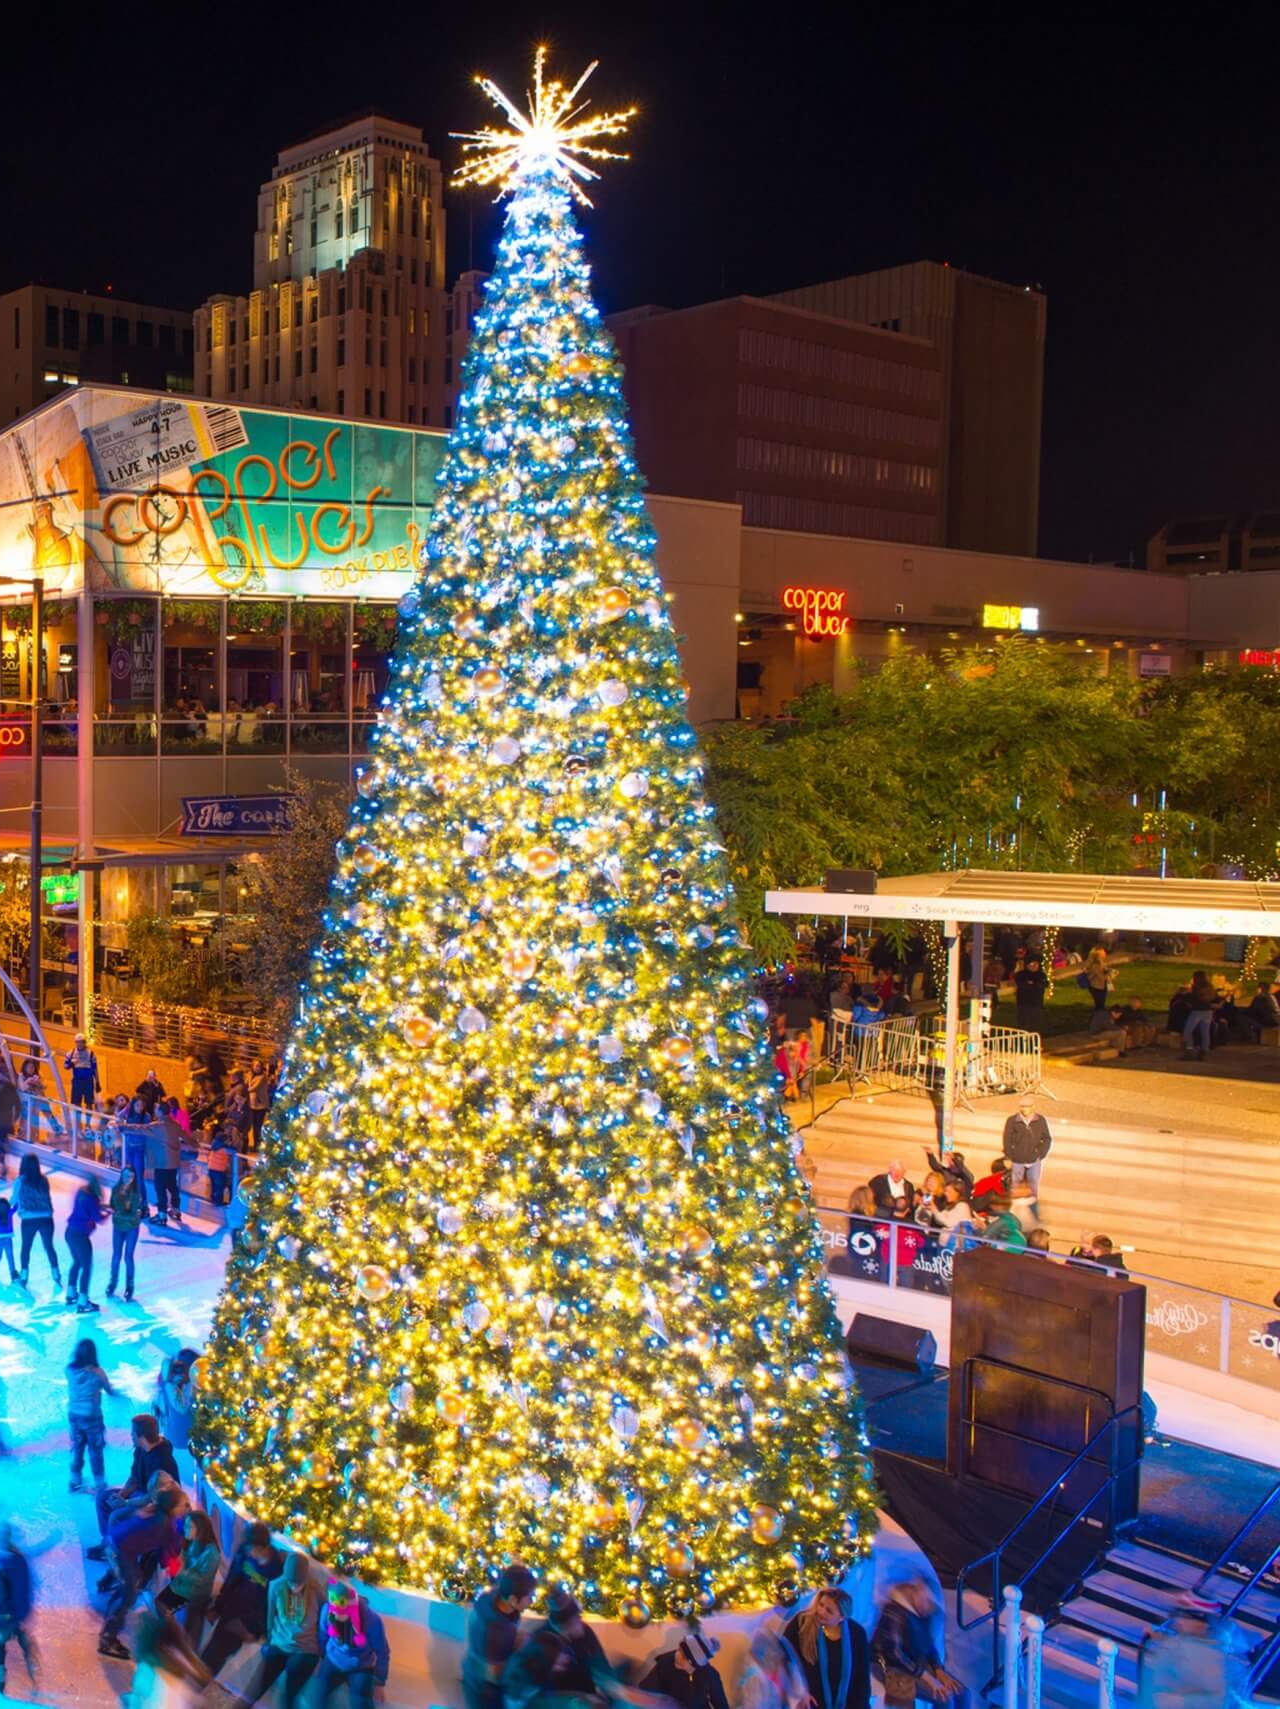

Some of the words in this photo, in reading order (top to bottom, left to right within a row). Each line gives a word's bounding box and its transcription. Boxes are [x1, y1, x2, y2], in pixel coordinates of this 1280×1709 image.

[151, 418, 170, 434] 4-7
[108, 460, 143, 483] LIVE
[147, 440, 197, 469] MUSIC
[103, 428, 341, 546] copper
[205, 486, 388, 590] blues
[320, 557, 372, 592] ROCK
[372, 544, 410, 575] PUB
[784, 588, 846, 612] copper
[803, 614, 850, 635] blues
[133, 632, 154, 653] LIV
[198, 802, 234, 828] The
[853, 903, 870, 912] nrg
